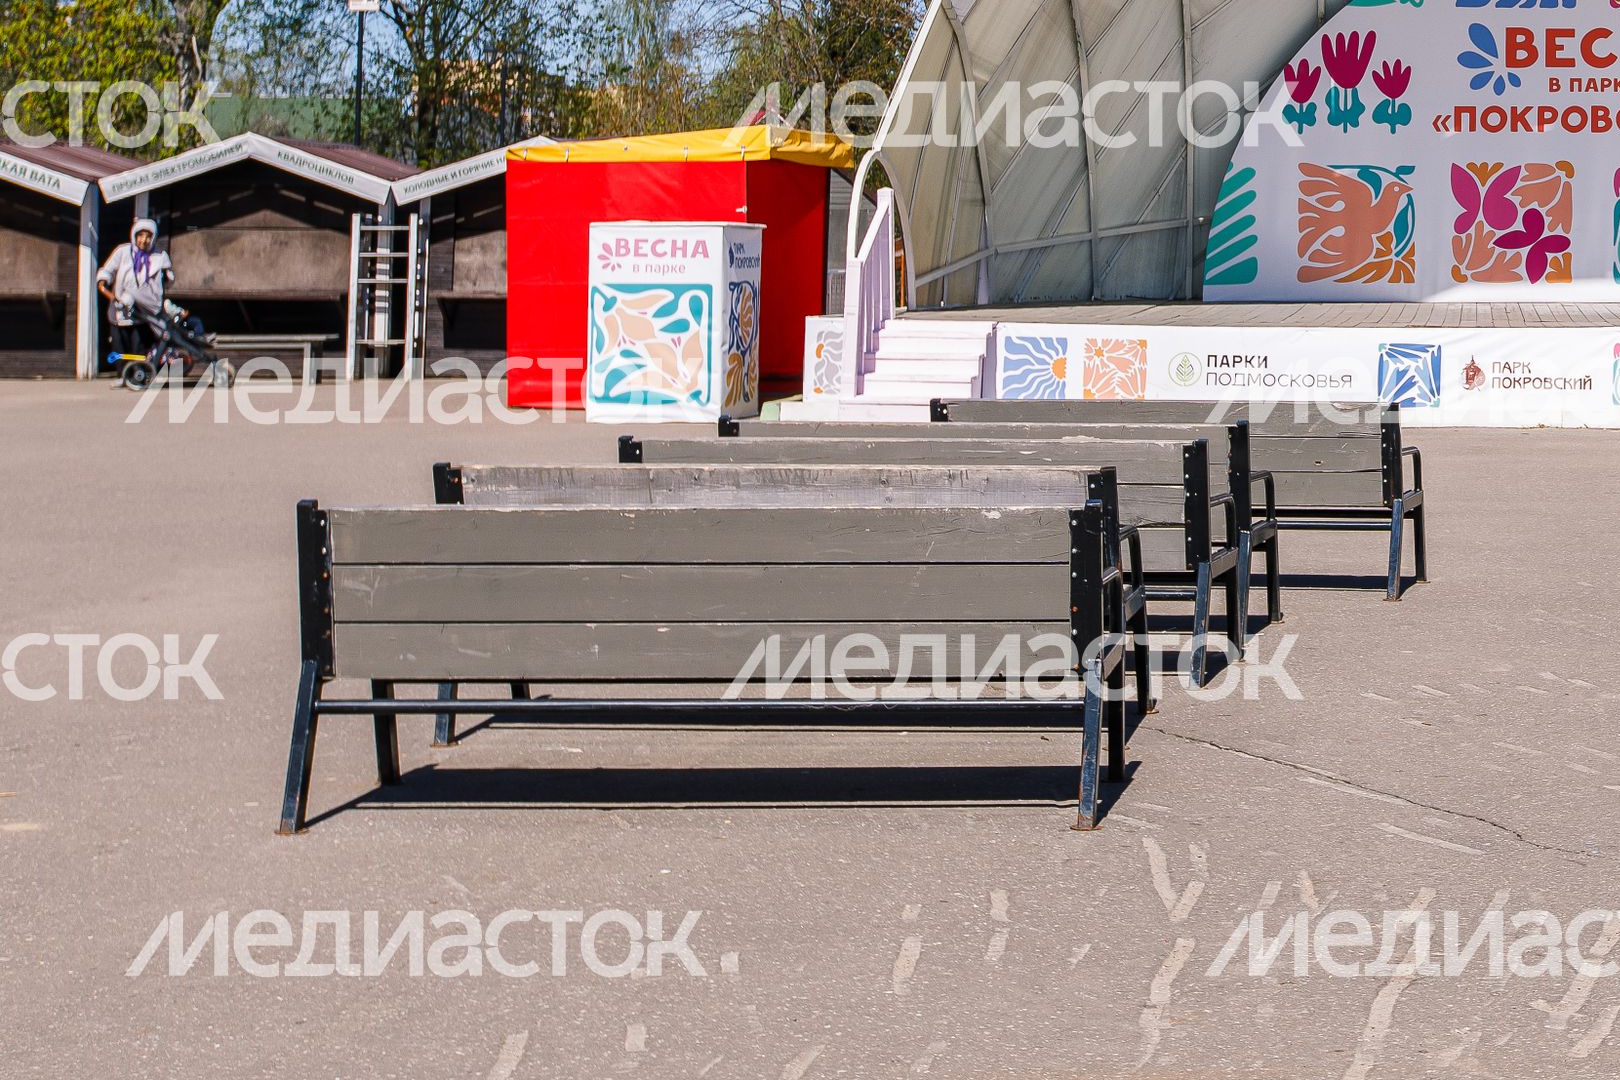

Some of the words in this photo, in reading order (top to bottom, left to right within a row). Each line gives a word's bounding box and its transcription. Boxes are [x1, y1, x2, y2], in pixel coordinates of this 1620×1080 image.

[1549, 77, 1561, 93] В
[277, 151, 354, 185] КВАДРОЦИКЛОВ
[30, 169, 61, 189] ВАТА
[614, 238, 710, 258] ВЕСНА
[645, 264, 686, 276] парке
[1207, 354, 1268, 369] ПАРКИ
[1492, 361, 1531, 374] ПАРК
[1206, 372, 1352, 388] ПОДМОСКОВЬЯ
[1492, 375, 1592, 390] ПОКРОВСКИЙ
